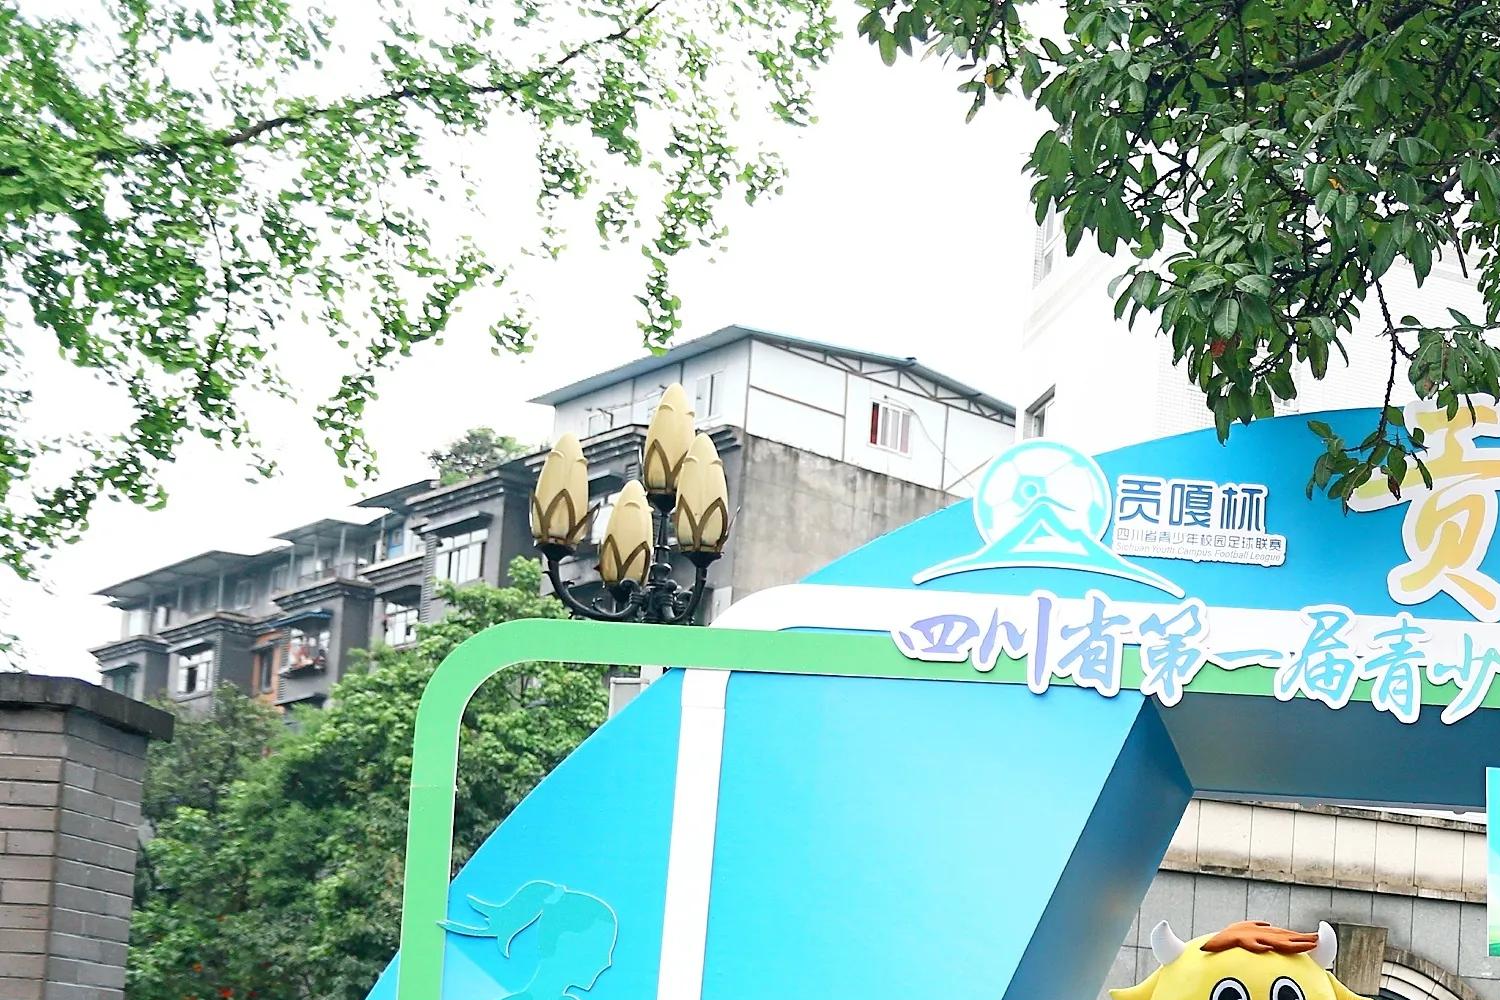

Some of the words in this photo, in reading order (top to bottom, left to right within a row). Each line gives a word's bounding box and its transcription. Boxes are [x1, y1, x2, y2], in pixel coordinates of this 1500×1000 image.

[1119, 479, 1264, 532] 贡嘎杯
[1117, 527, 1282, 552] 四川省青少年校园足球联赛
[1116, 543, 1150, 552] Sichuan
[1151, 544, 1176, 553] Youth
[1177, 546, 1212, 558] Campus
[1214, 549, 1249, 560] Football
[1250, 551, 1281, 563] League
